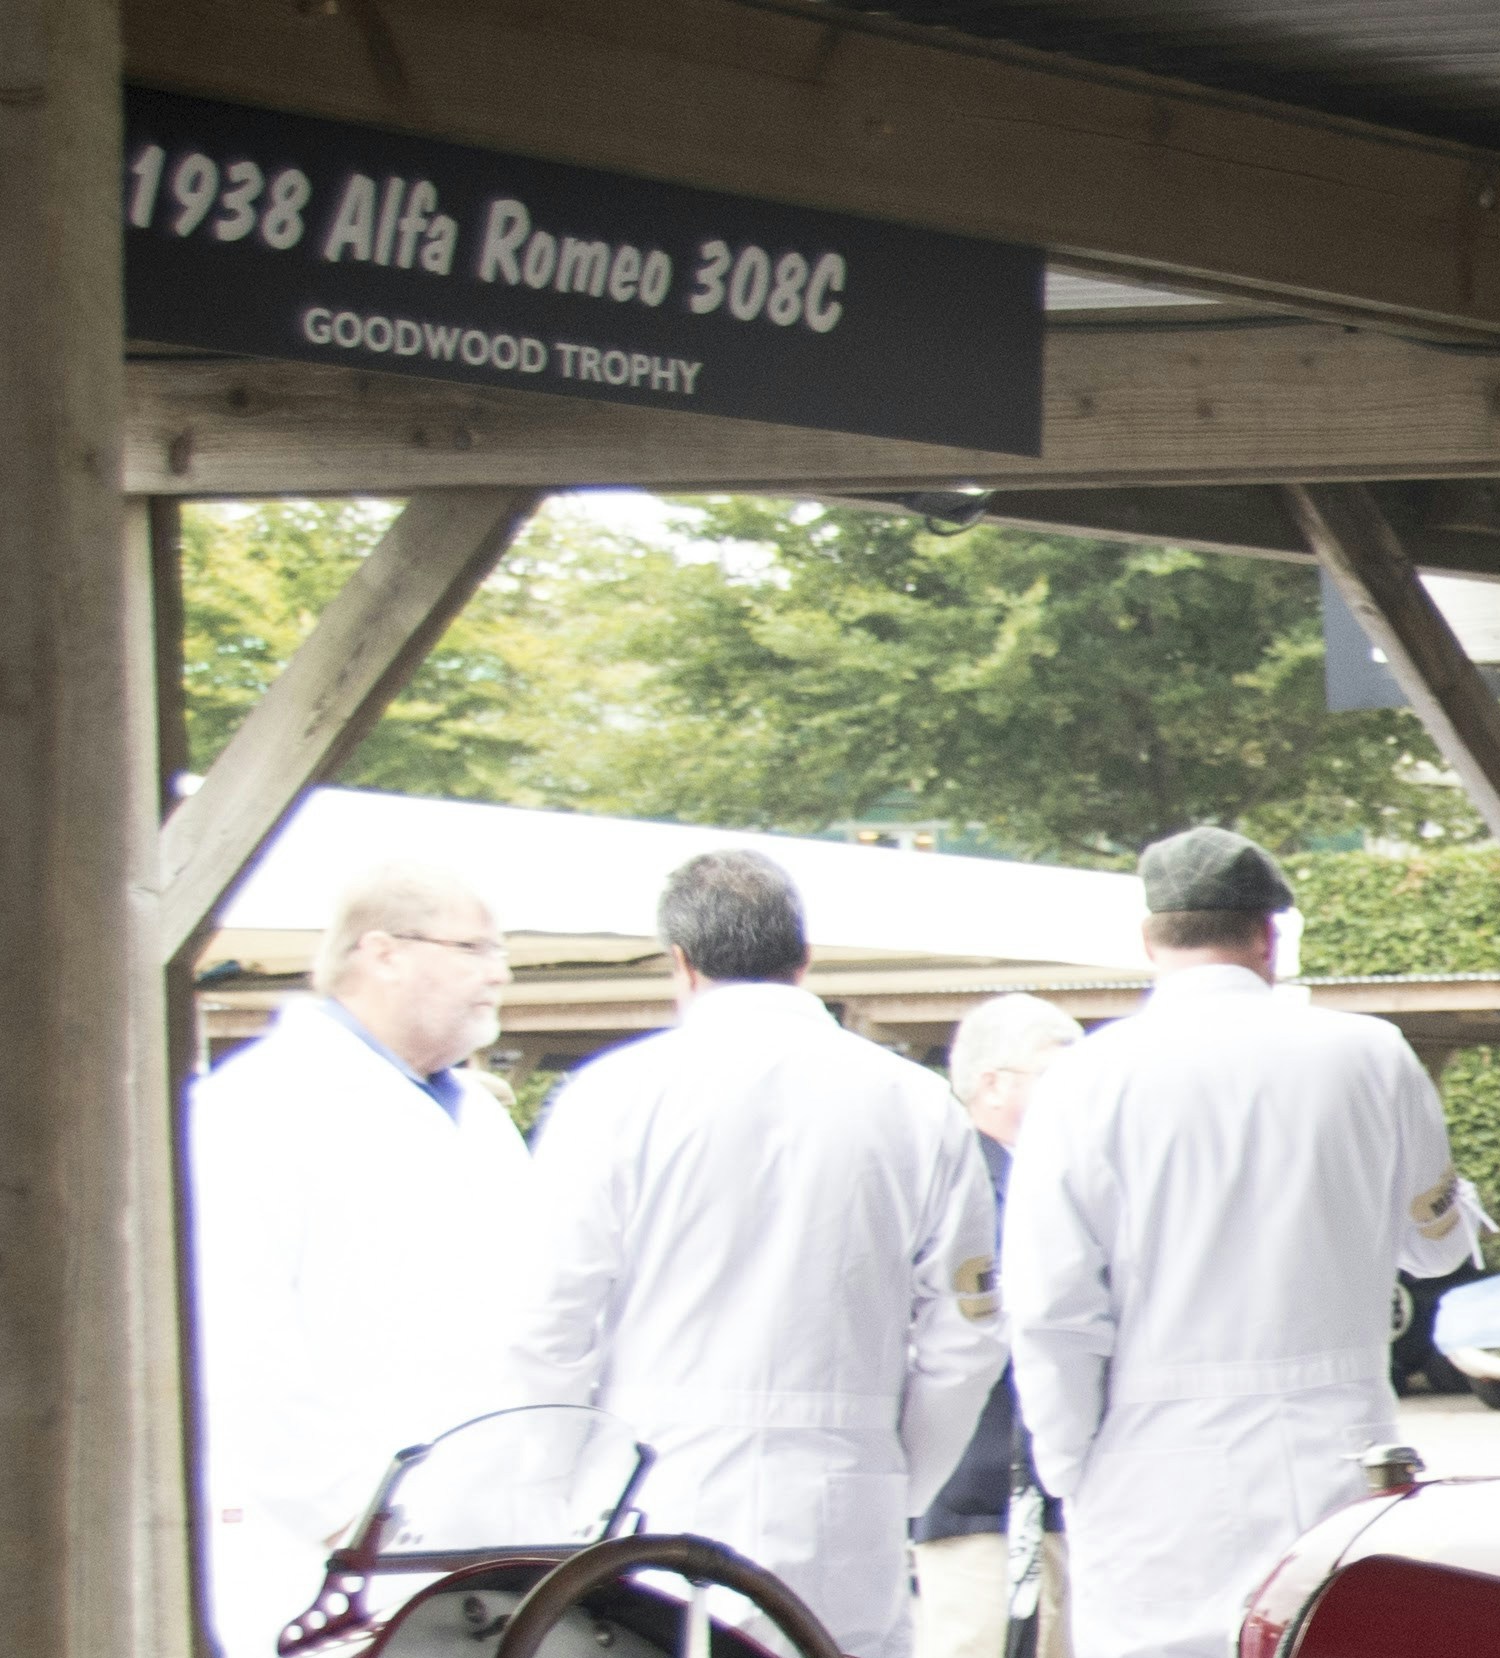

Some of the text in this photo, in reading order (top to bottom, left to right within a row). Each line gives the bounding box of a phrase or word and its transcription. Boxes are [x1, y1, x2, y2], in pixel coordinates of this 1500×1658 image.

[127, 142, 848, 336] 1938 Alfa Romeo 308C
[301, 307, 704, 397] GOODWOOD TROPHY
